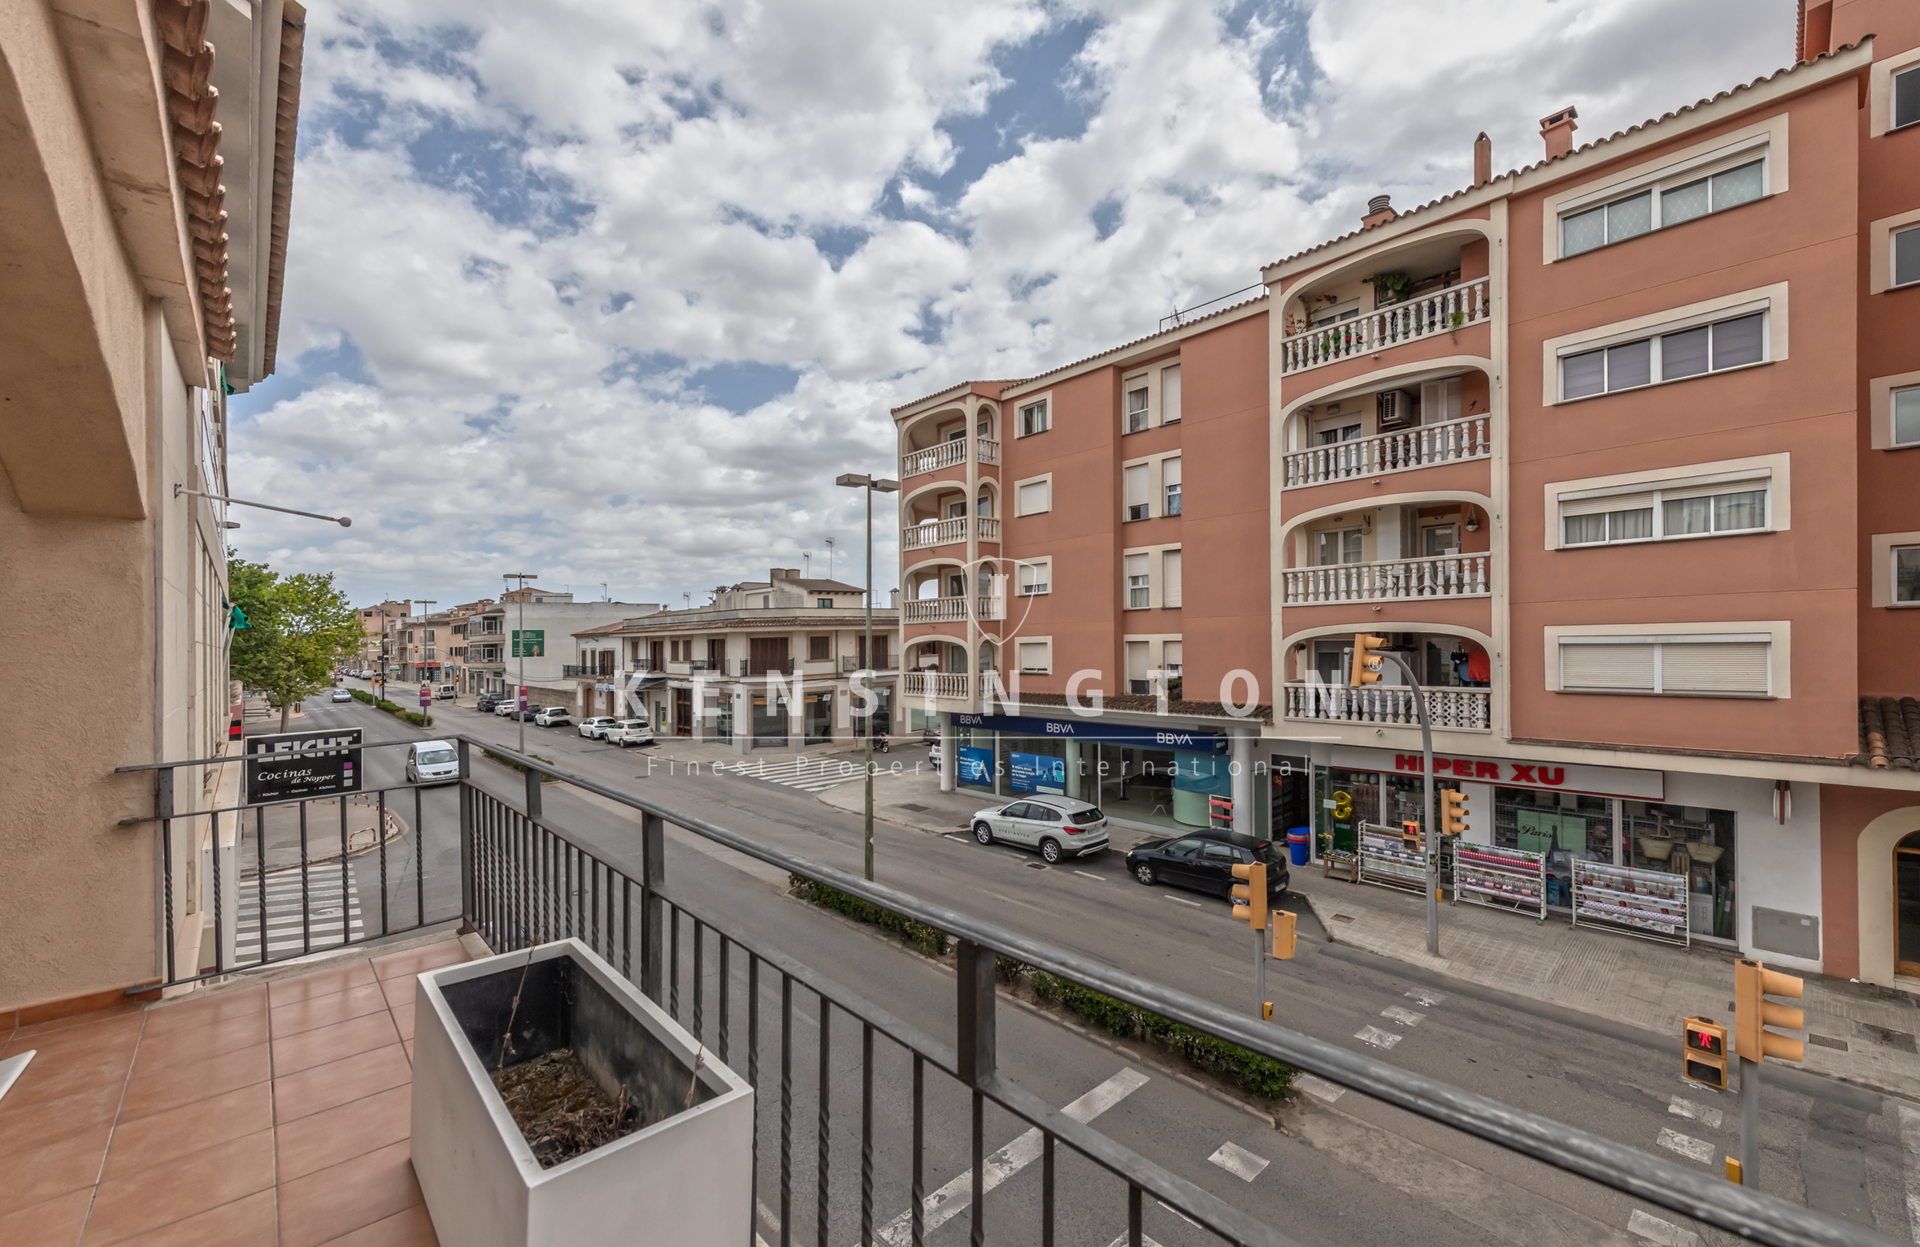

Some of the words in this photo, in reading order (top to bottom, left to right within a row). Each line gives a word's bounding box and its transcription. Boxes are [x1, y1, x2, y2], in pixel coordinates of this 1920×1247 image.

[960, 714, 982, 725] BBVA
[1046, 722, 1074, 734] BBVA
[1156, 732, 1193, 745] BBVA
[1215, 741, 1226, 749] BBVA
[257, 737, 353, 763] LEICHT
[257, 768, 312, 781] Cocinas
[1395, 754, 1499, 779] HIPER
[1511, 763, 1564, 786] XU
[303, 773, 336, 783] Nopper
[1516, 825, 1553, 839] Paris
